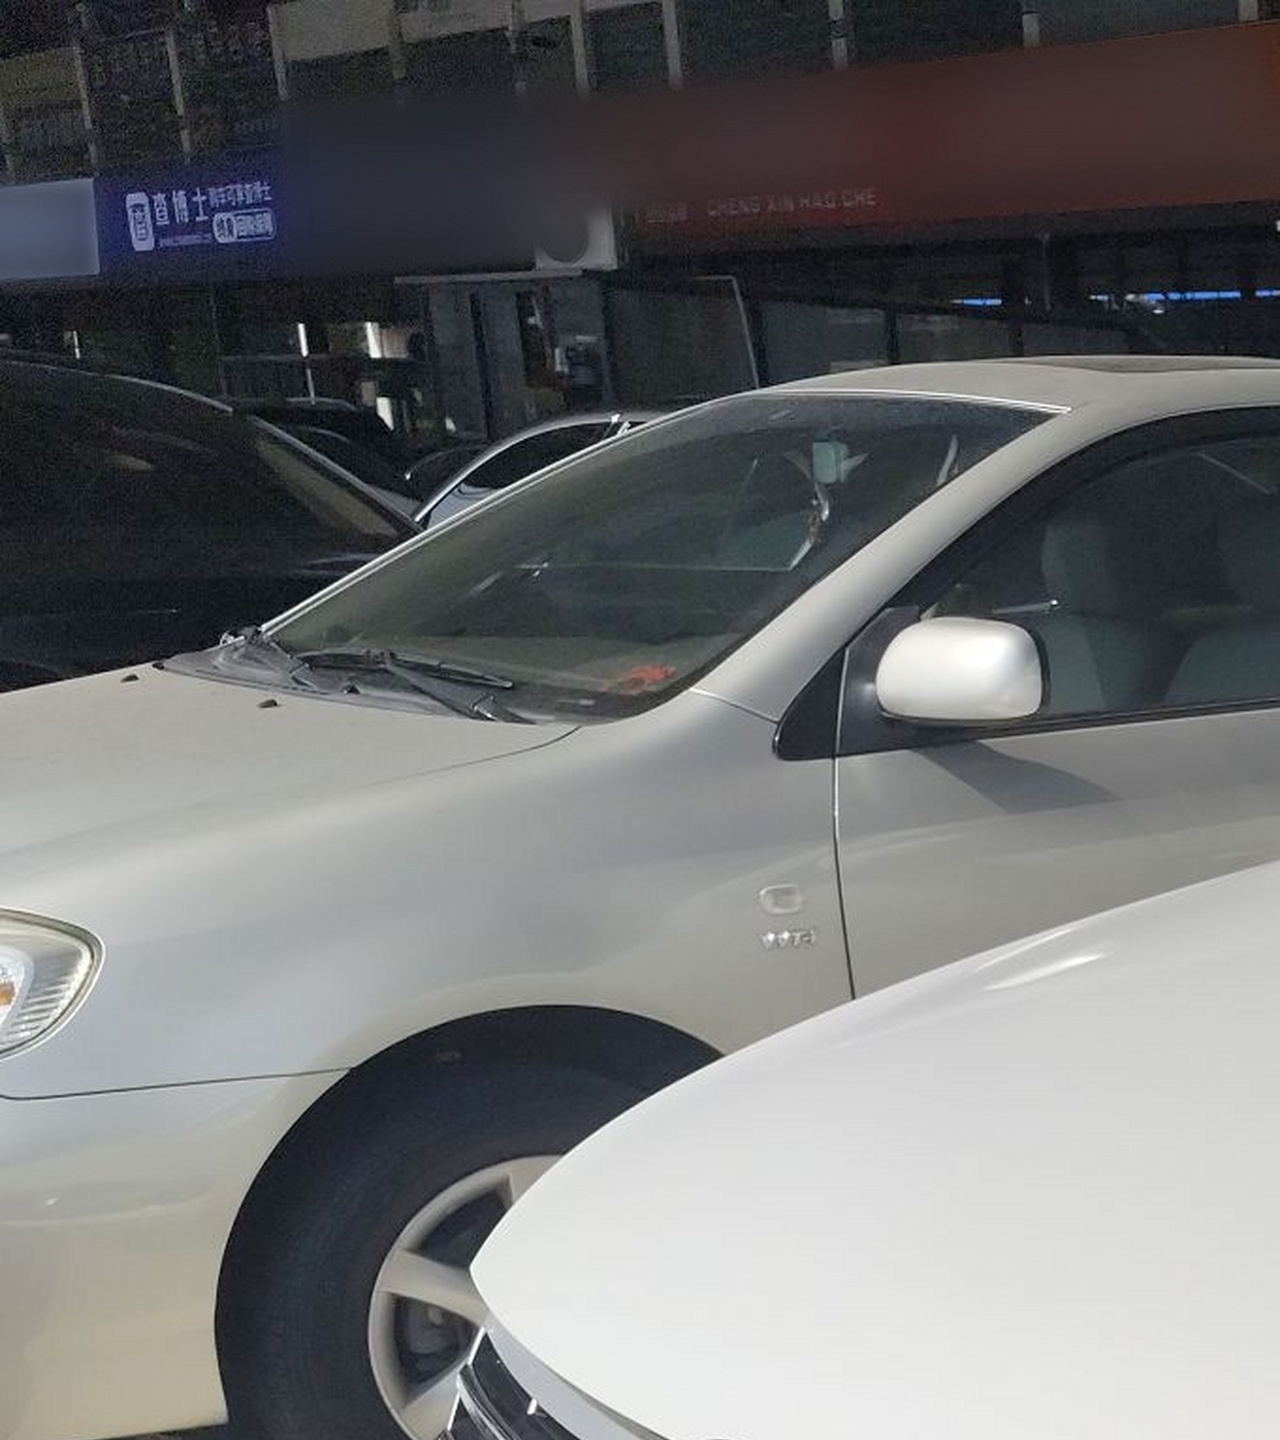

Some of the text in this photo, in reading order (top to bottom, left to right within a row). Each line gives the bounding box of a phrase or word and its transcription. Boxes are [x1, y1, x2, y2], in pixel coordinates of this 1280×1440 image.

[152, 187, 210, 227] 查博士
[764, 192, 795, 213] XIN
[799, 189, 836, 209] HAO
[841, 186, 877, 208] CHE
